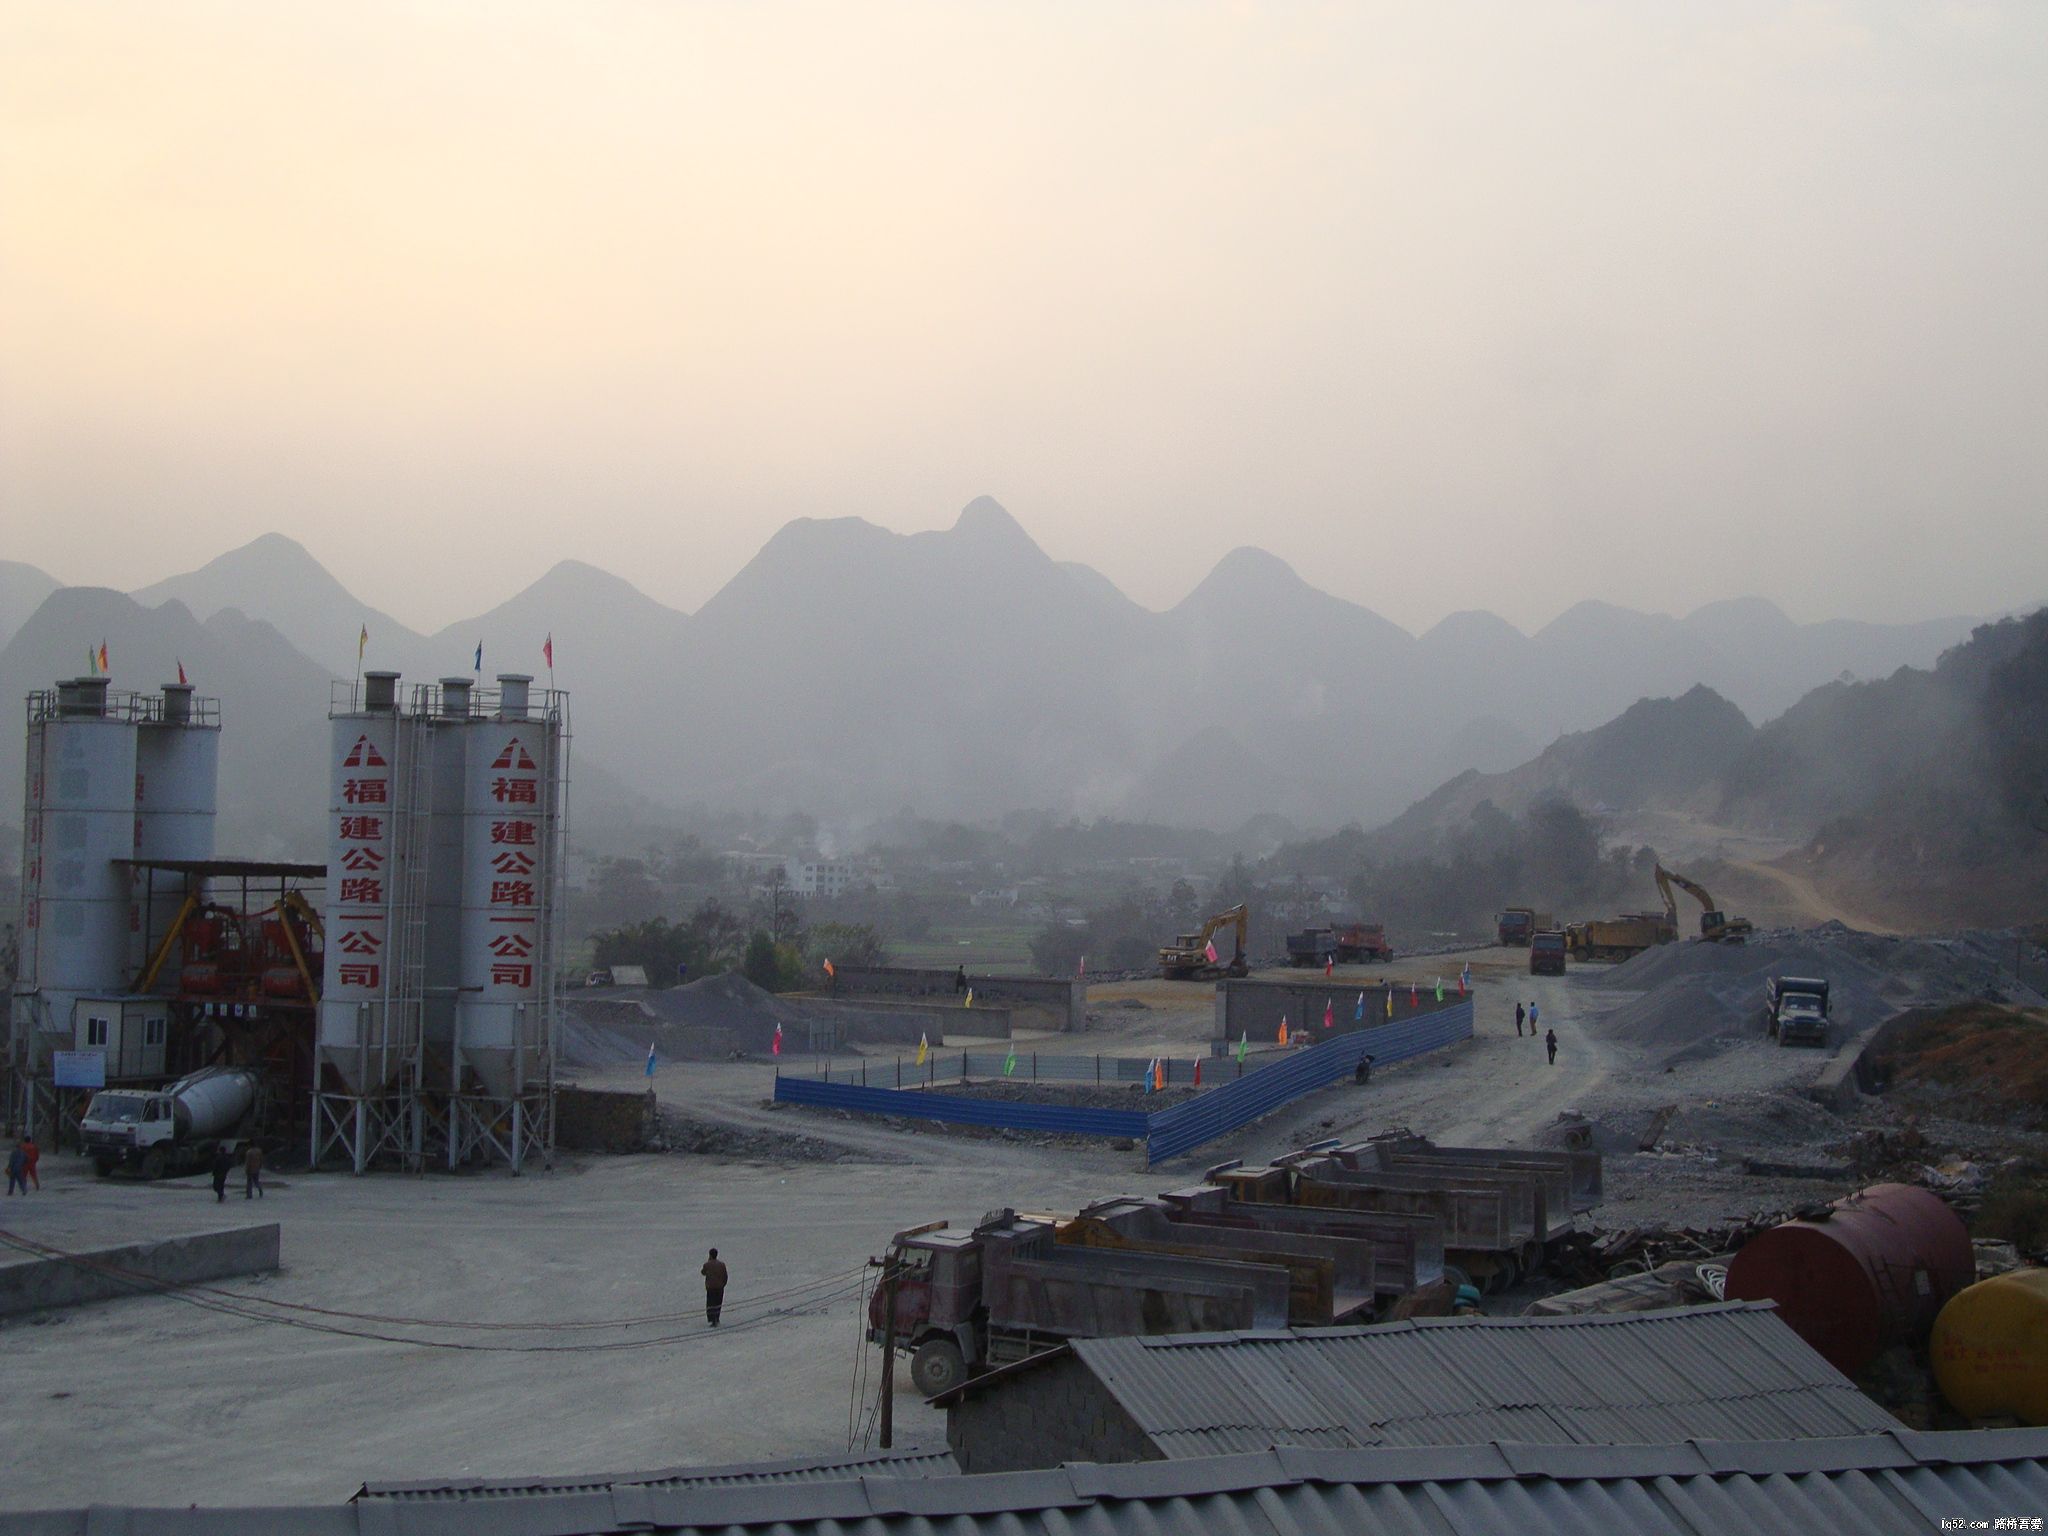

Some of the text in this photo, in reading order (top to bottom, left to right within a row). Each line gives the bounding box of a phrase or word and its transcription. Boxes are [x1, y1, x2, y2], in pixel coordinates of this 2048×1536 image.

[338, 779, 388, 988] 福建公路一公司
[488, 778, 537, 988] 福建公路一公司
